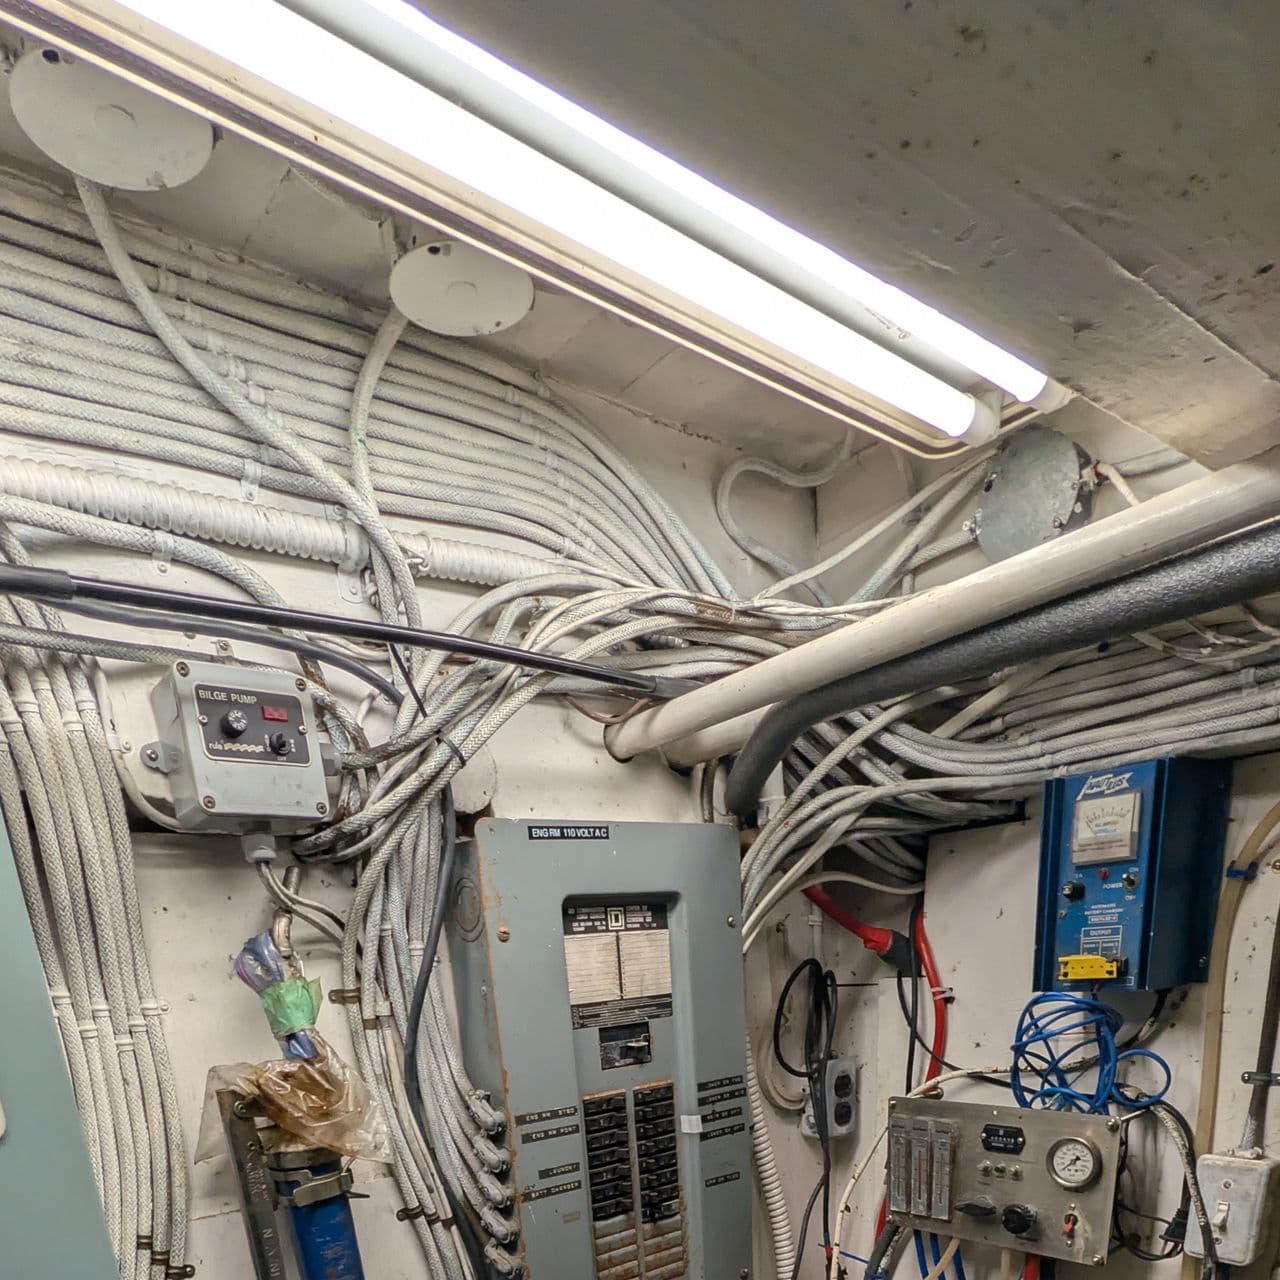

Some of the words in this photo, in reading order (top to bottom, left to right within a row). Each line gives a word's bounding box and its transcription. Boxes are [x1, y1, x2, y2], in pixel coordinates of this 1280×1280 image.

[199, 689, 228, 701] BILGE
[231, 693, 257, 704] PUMP
[532, 828, 549, 838] ENG
[549, 828, 561, 838] RM
[563, 828, 576, 838] 110
[1103, 882, 1123, 890] POWER
